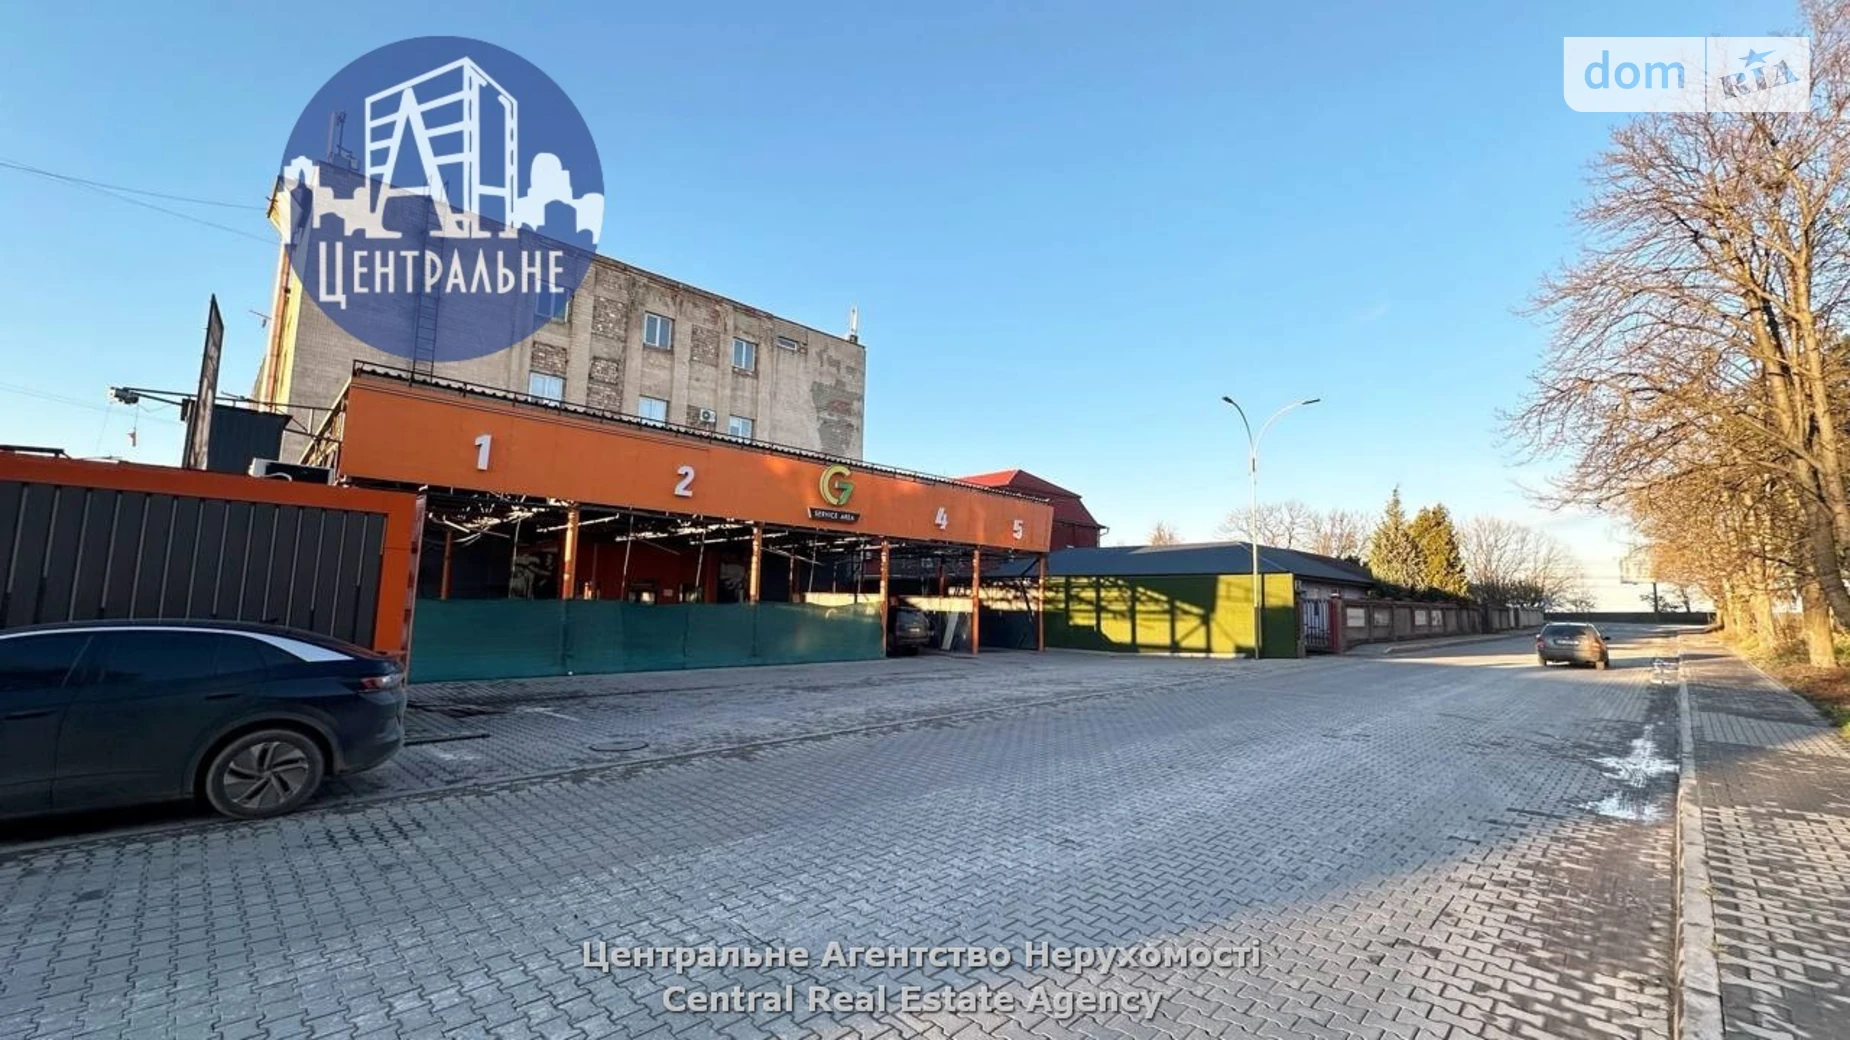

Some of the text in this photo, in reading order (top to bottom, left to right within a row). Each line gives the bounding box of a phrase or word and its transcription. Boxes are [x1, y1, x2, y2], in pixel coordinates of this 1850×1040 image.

[474, 434, 492, 471] 1
[674, 464, 695, 497] 2
[814, 509, 855, 521] SERVICE AREA
[935, 507, 948, 530] 4
[1012, 519, 1024, 540] 5
